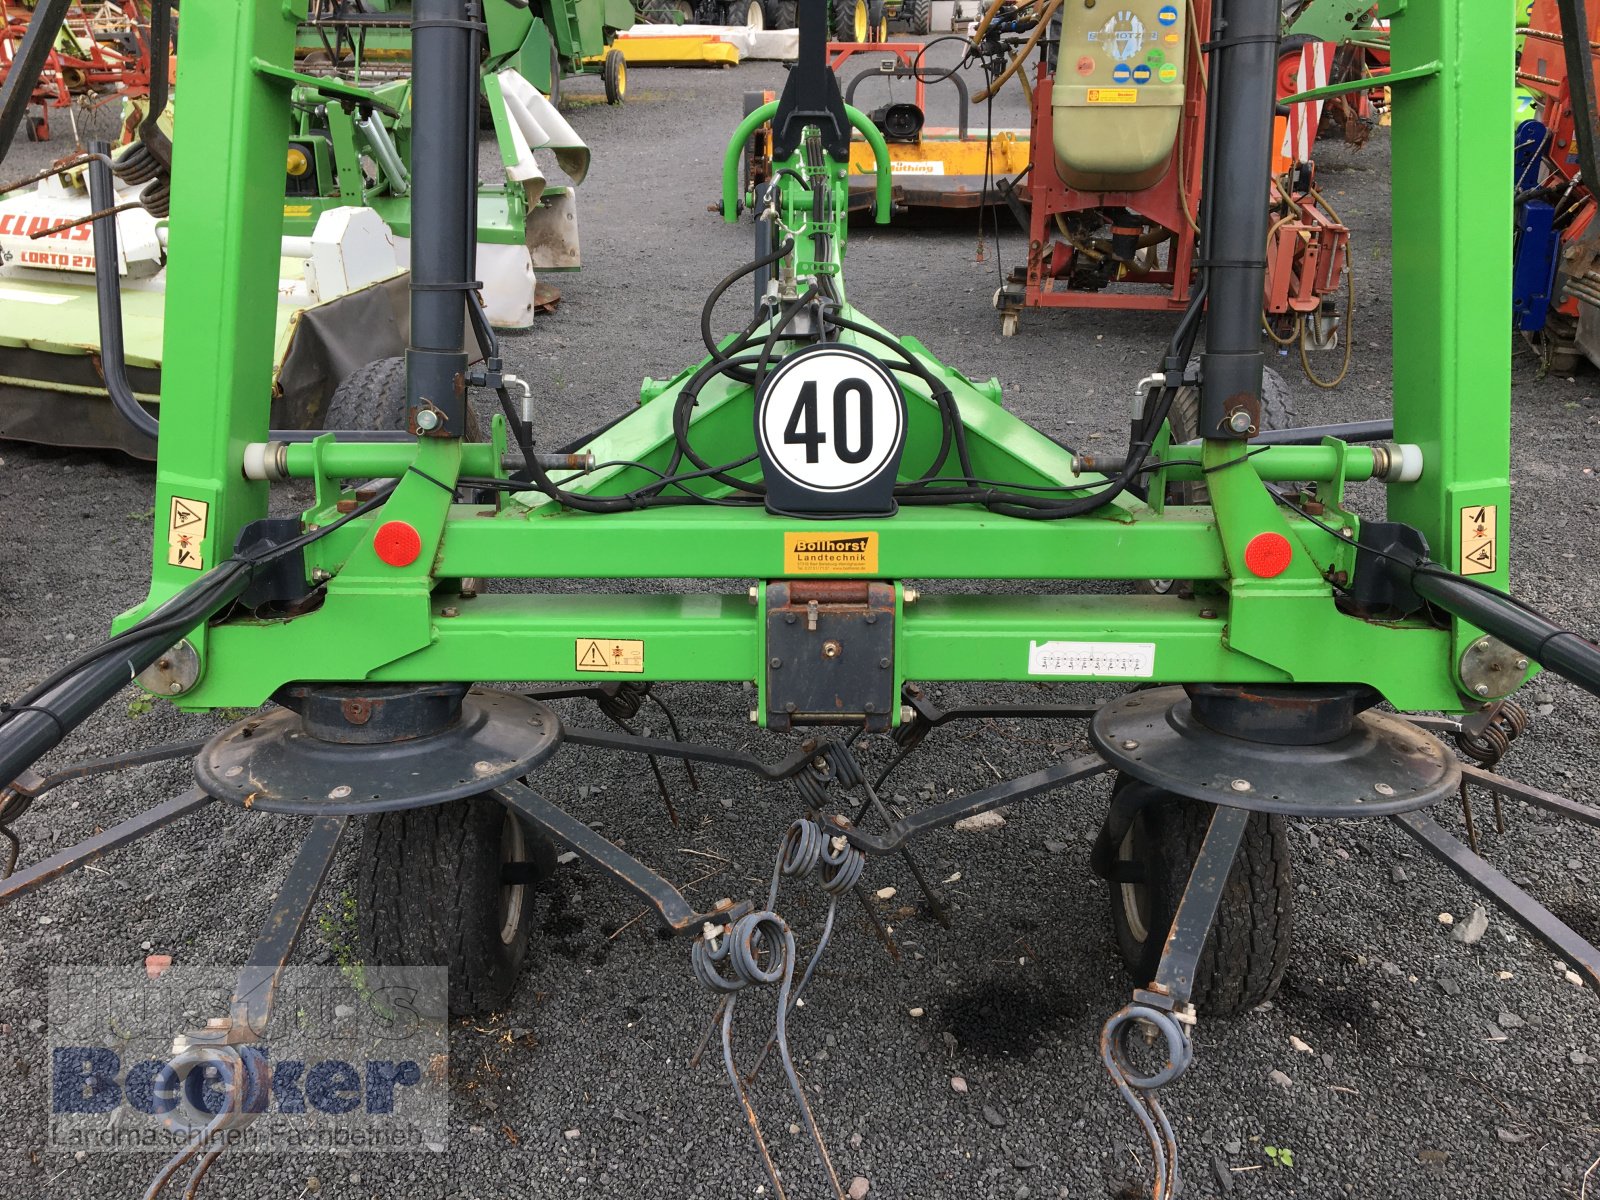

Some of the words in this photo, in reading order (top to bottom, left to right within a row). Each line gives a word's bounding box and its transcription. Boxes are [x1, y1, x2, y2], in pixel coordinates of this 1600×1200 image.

[0, 214, 92, 240] CLAAS
[72, 255, 96, 269] 27
[784, 377, 873, 464] 40
[796, 540, 867, 551] Bollhorst
